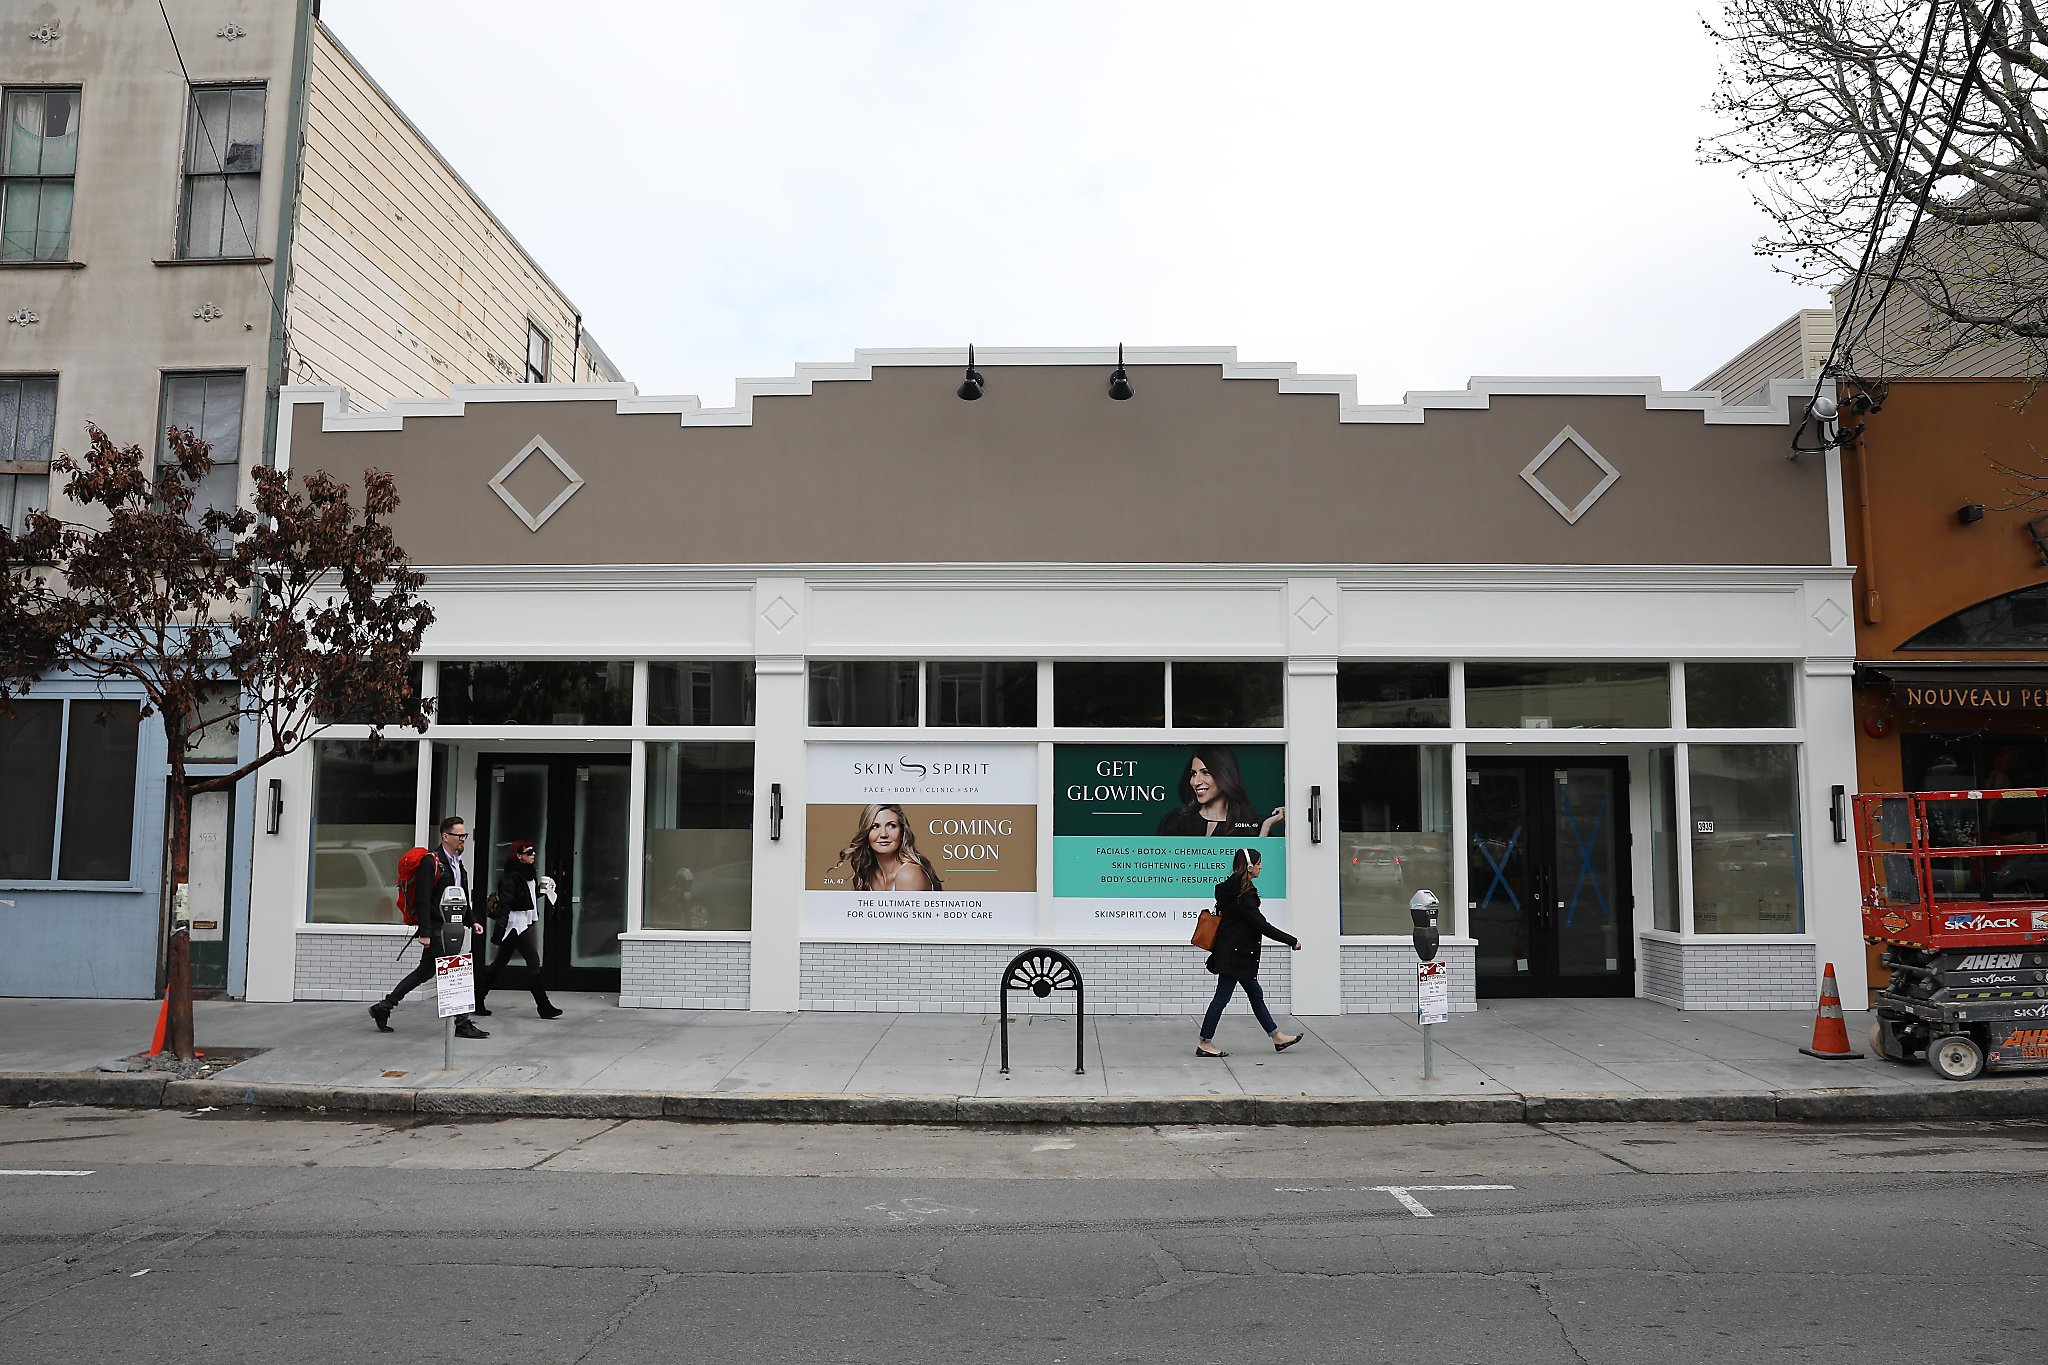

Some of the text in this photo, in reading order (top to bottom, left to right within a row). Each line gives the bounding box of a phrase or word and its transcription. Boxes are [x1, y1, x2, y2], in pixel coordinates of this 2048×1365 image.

[1907, 687, 2011, 707] NOUVEAU
[853, 762, 990, 775] SKIN SPIRIT
[1096, 760, 1138, 777] GET
[1067, 785, 1165, 801] GLOWING
[929, 819, 1012, 836] COMING
[1698, 822, 1712, 831] 3939
[942, 844, 999, 860] SOON
[1194, 862, 1226, 870] FILLERS
[858, 899, 874, 907] THE
[924, 900, 982, 908] DESTINATION
[847, 910, 864, 918] FOR
[867, 910, 909, 918] GLOWING
[943, 911, 968, 919] BODY
[971, 911, 993, 919] CARE
[1094, 910, 1167, 918] SKINSPIRIT.COM
[1944, 914, 2020, 931] SKYJACK
[1956, 953, 2023, 970] AHERN
[1970, 973, 2017, 984] SKYJACK
